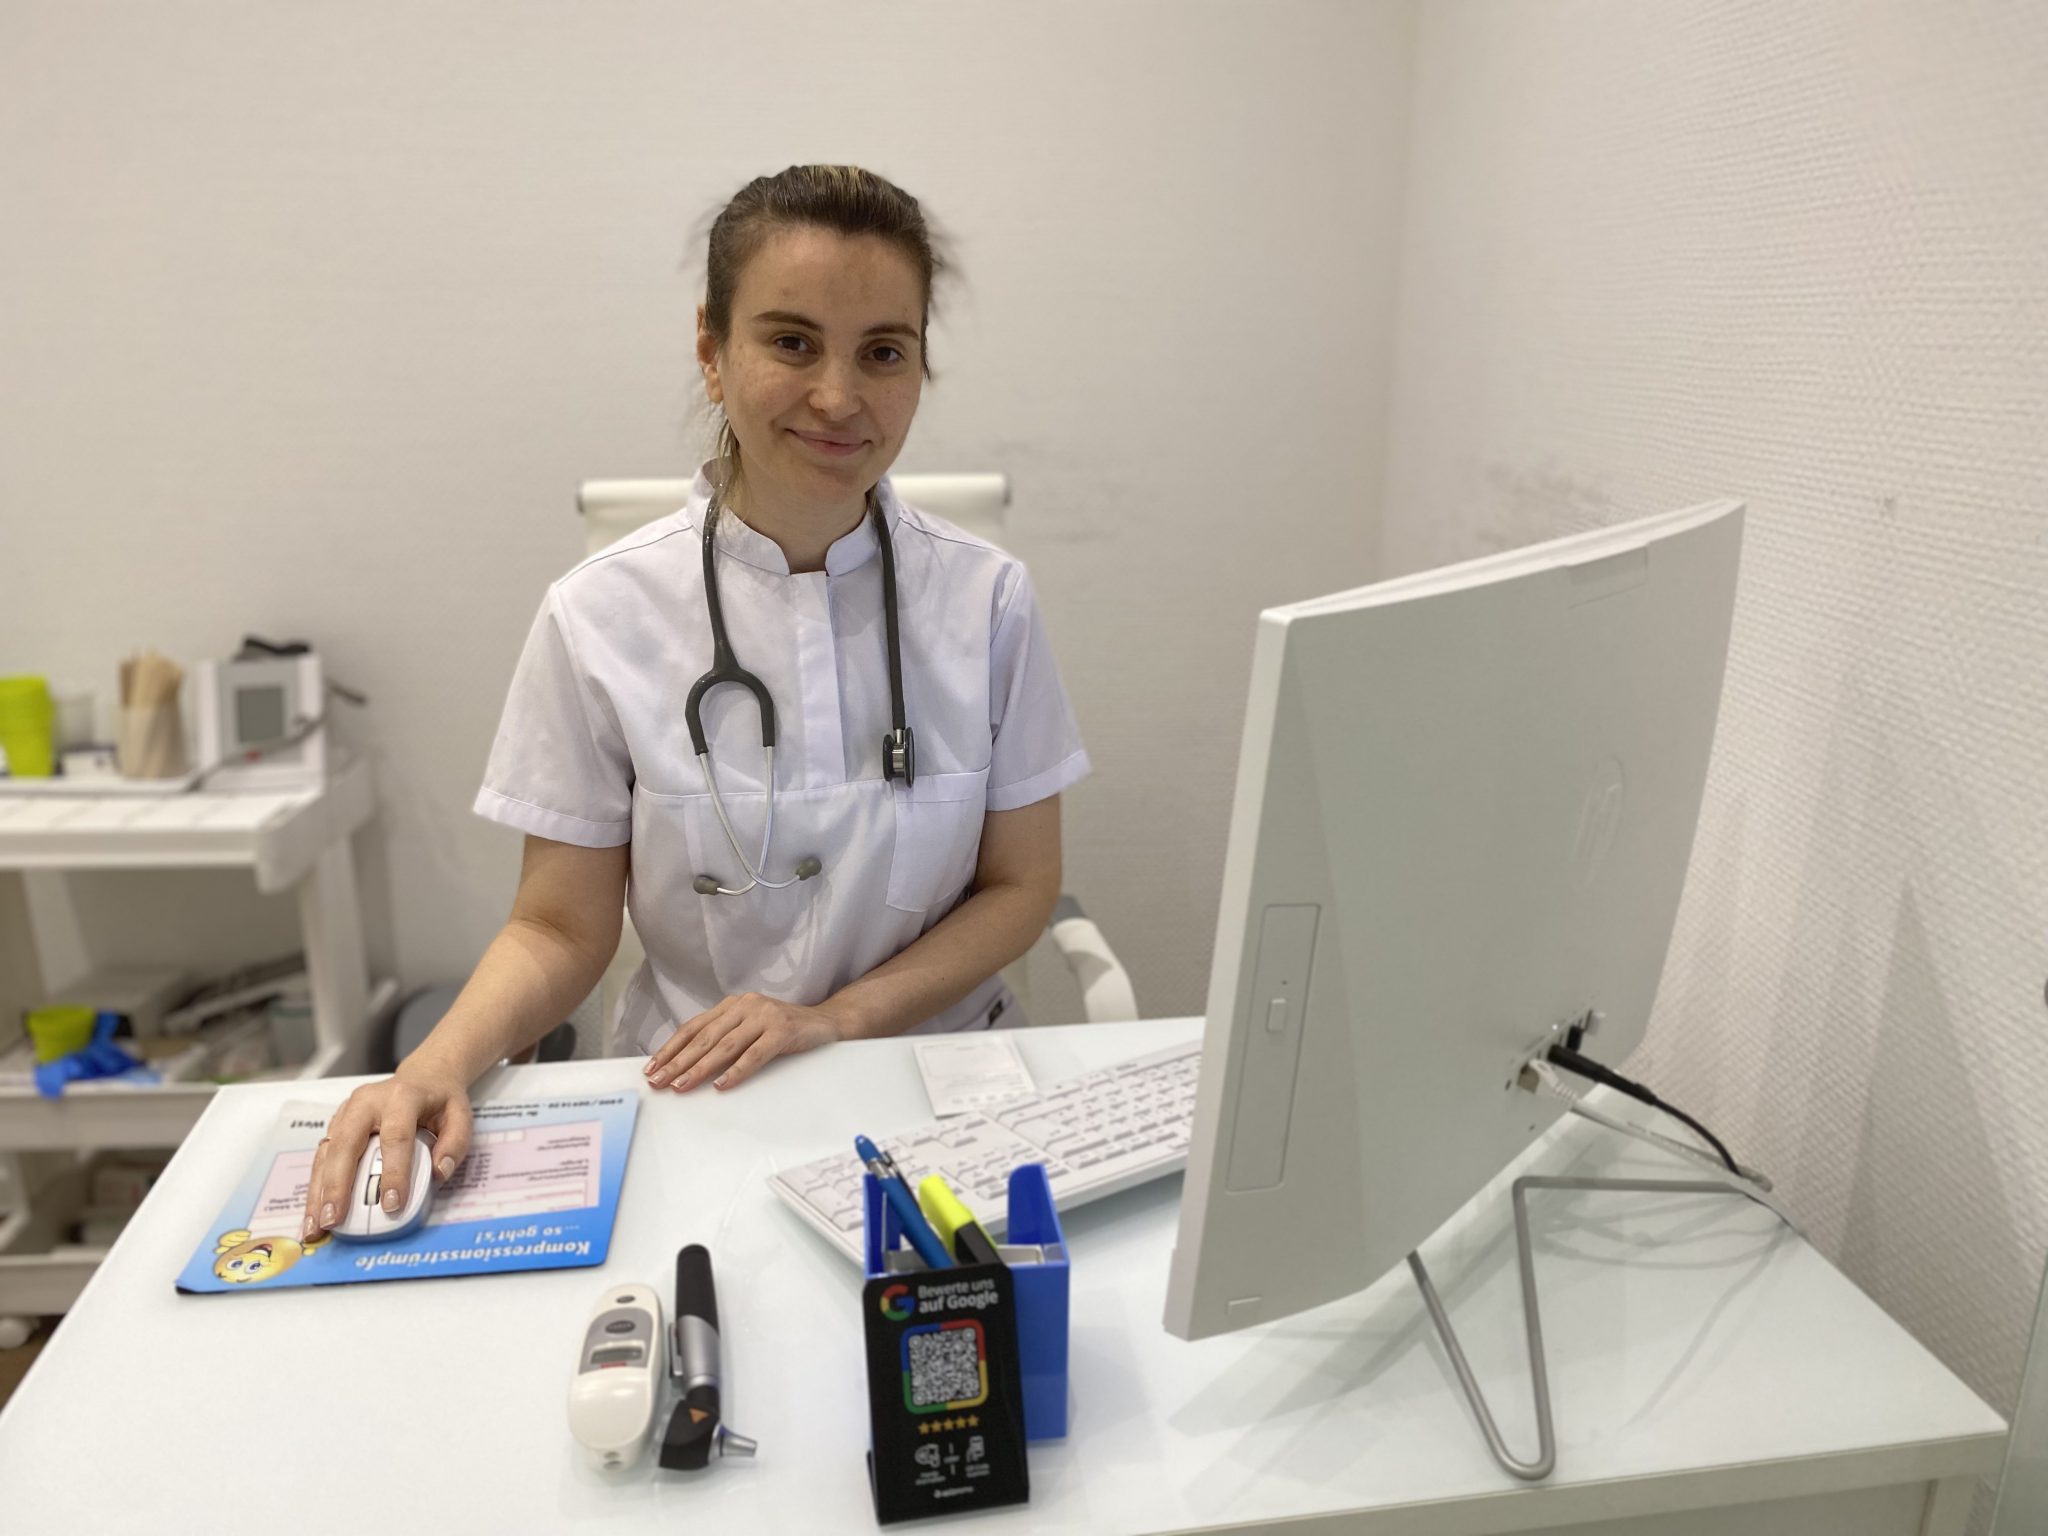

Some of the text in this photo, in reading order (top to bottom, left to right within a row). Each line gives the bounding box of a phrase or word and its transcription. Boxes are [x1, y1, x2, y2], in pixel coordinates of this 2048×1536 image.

[354, 1241, 591, 1271] Kompressionsstrümpfe
[917, 1279, 995, 1299] Bewerte uns
[919, 1290, 999, 1313] auf Google
